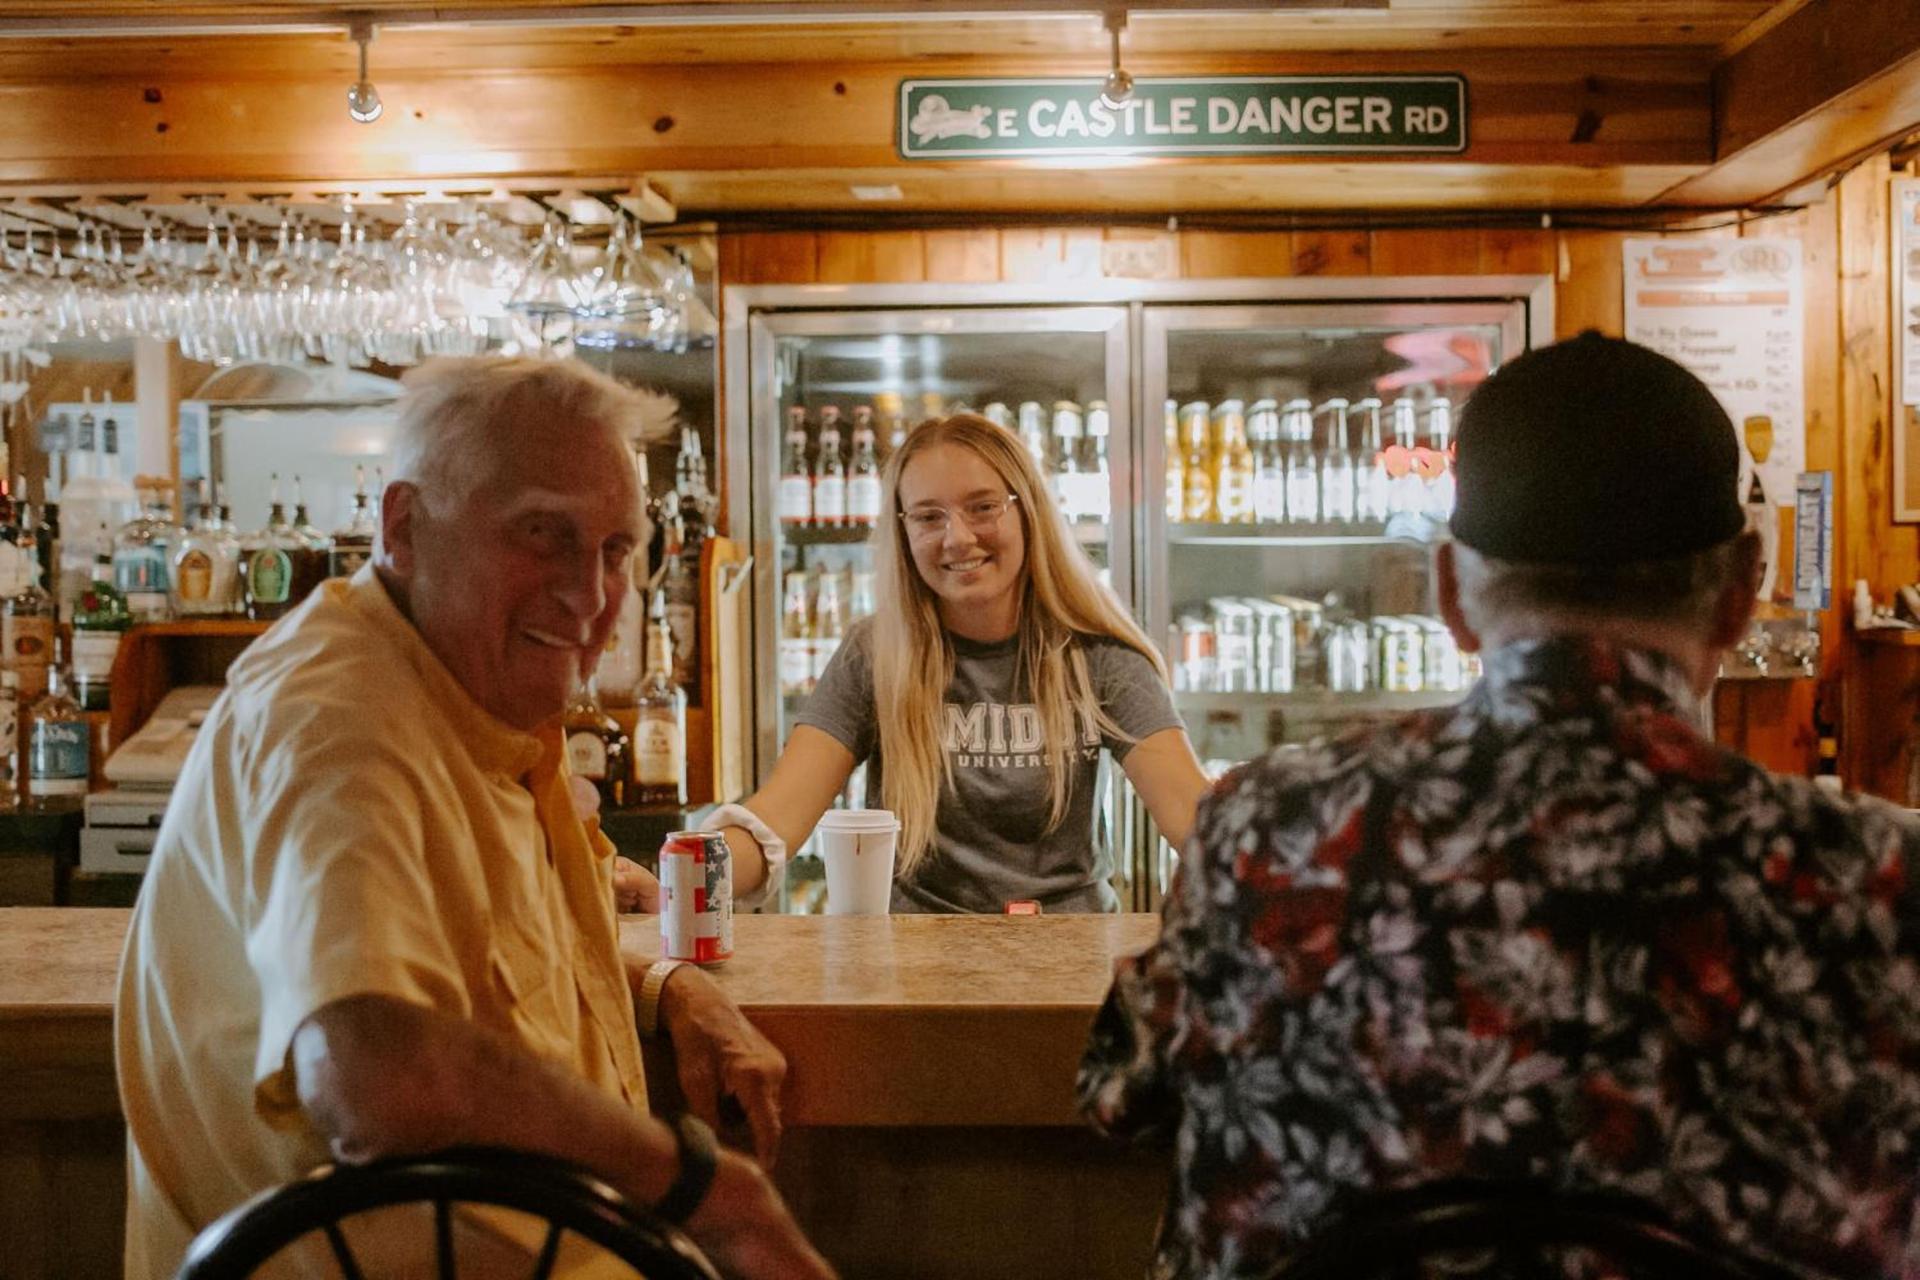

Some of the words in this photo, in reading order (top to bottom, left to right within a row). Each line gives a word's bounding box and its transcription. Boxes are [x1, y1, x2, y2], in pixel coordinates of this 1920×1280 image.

[997, 108, 1019, 137] E
[1028, 98, 1199, 137] CASTLE
[1207, 96, 1393, 134] DANGER
[1405, 106, 1449, 133] RD
